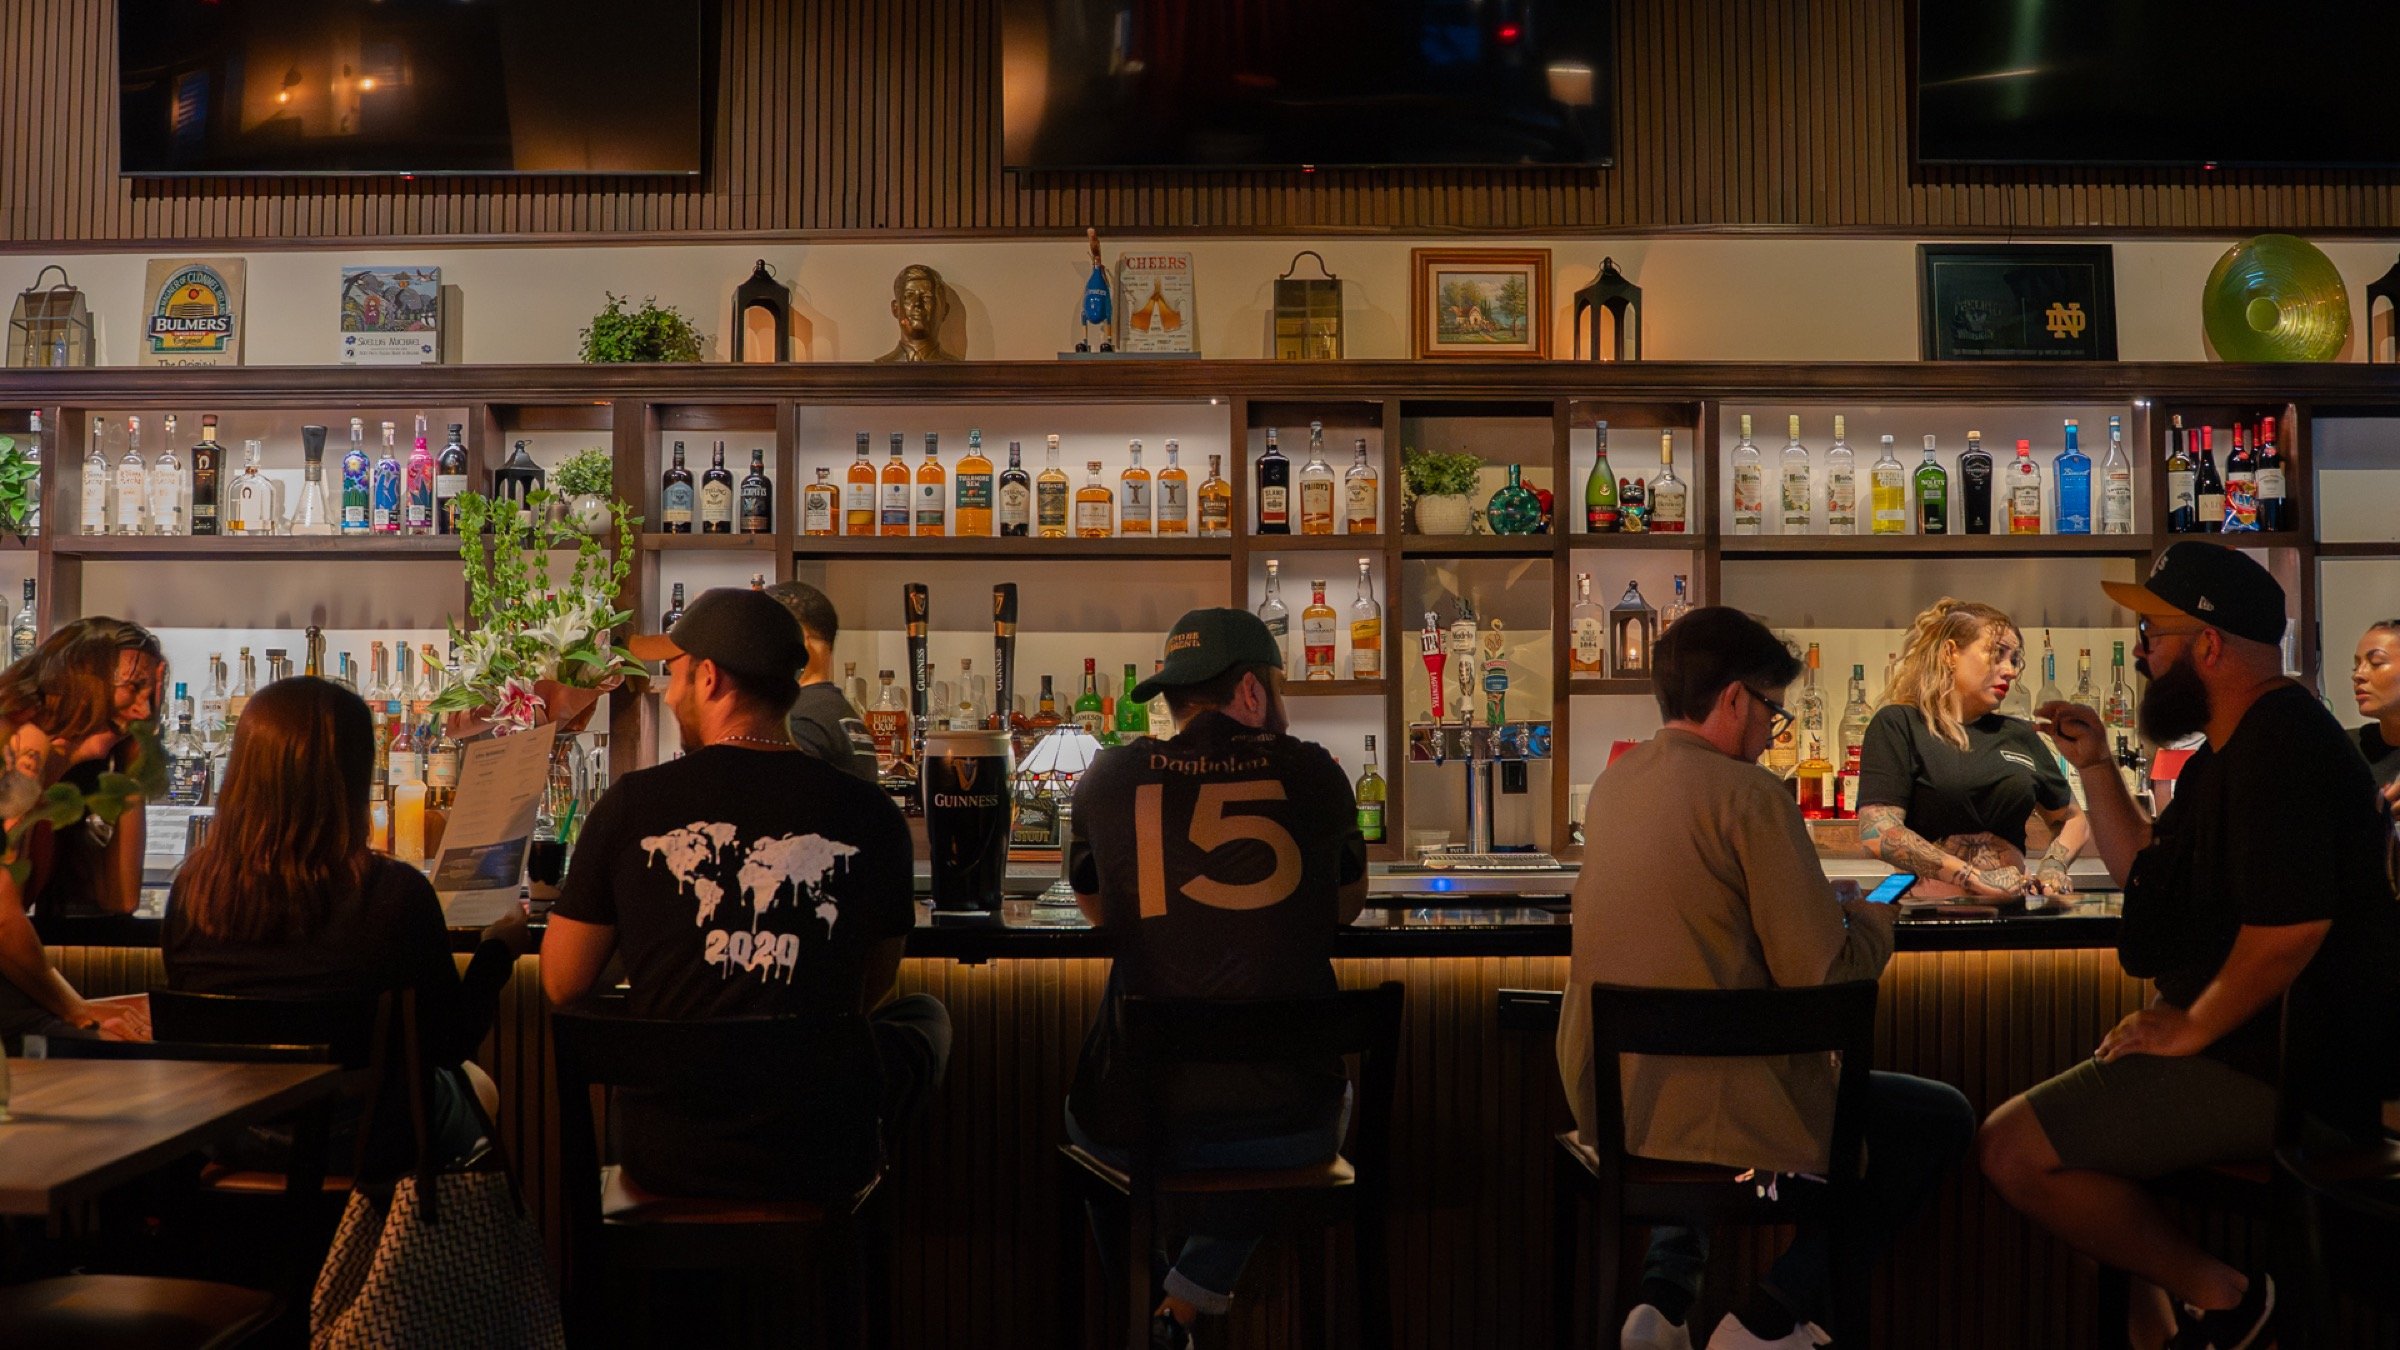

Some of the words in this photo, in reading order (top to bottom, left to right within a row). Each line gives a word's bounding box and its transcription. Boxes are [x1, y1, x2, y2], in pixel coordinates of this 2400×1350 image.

[1126, 256, 1186, 269] CHEERS
[155, 318, 228, 332] BULMERS
[916, 648, 925, 692] GUINNESS
[873, 722, 897, 731] CRAIG
[934, 793, 999, 807] GUINNESS
[1015, 830, 1050, 842] STOUT
[1134, 779, 1303, 919] 15
[704, 929, 800, 982] 2020
